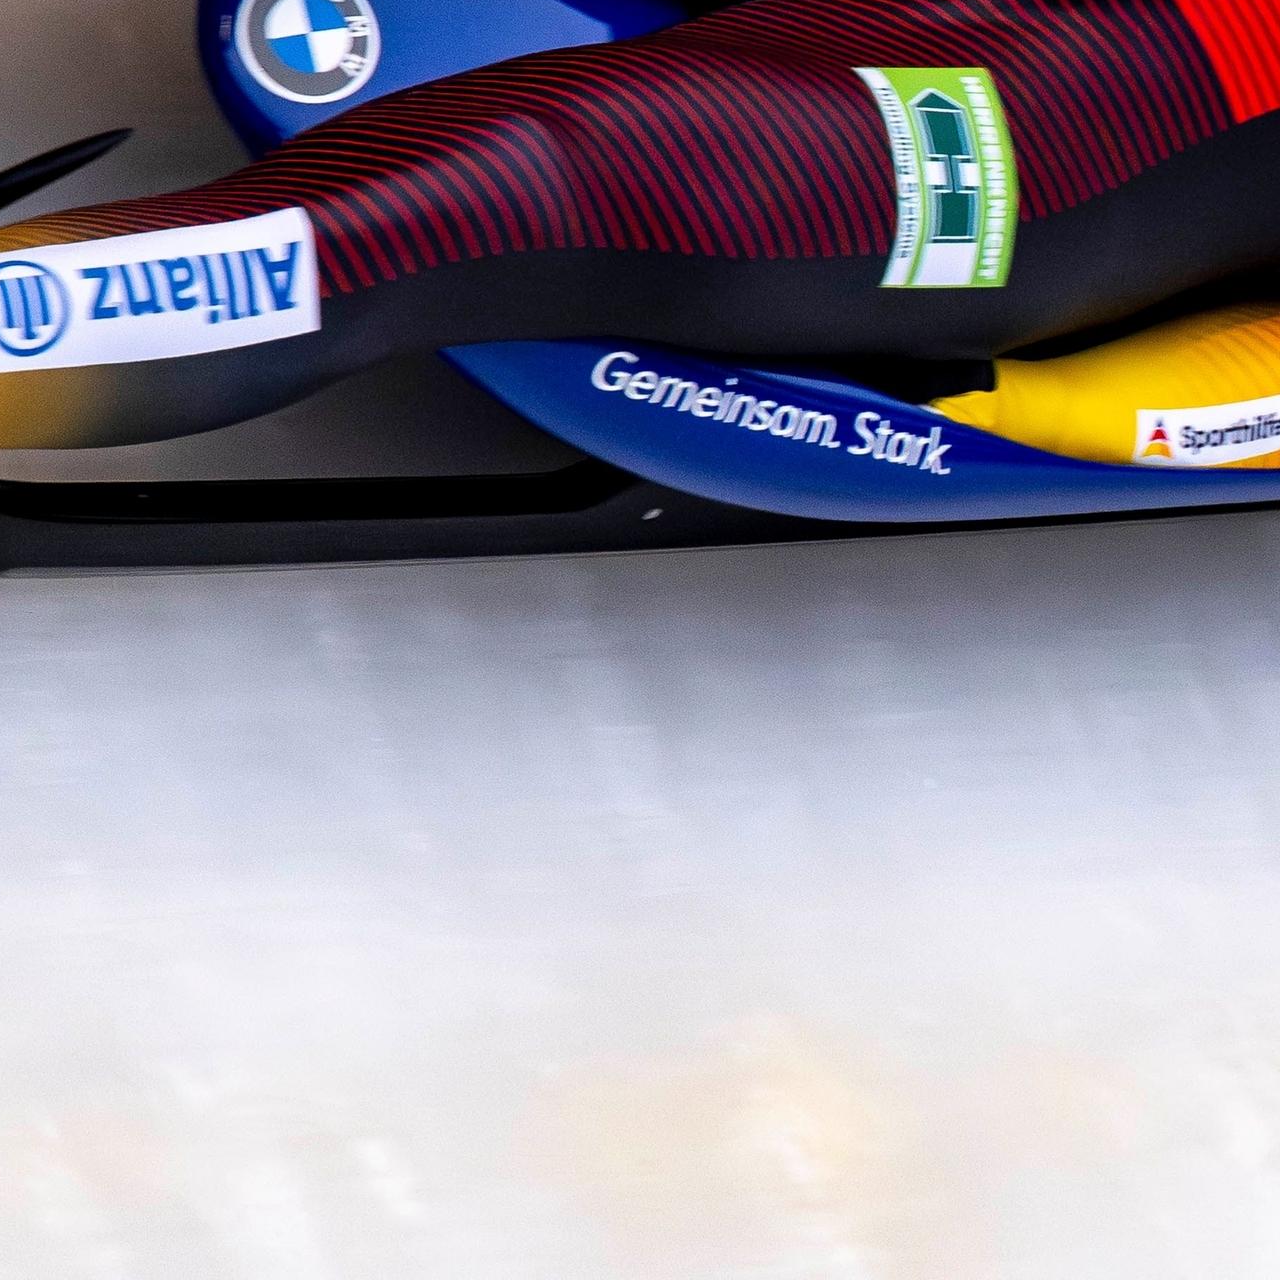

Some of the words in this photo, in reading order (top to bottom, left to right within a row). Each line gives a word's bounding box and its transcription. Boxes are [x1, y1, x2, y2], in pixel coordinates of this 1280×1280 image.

[81, 241, 303, 325] Allianz
[590, 350, 841, 449] Gemeinsam.
[846, 410, 952, 476] Stark.
